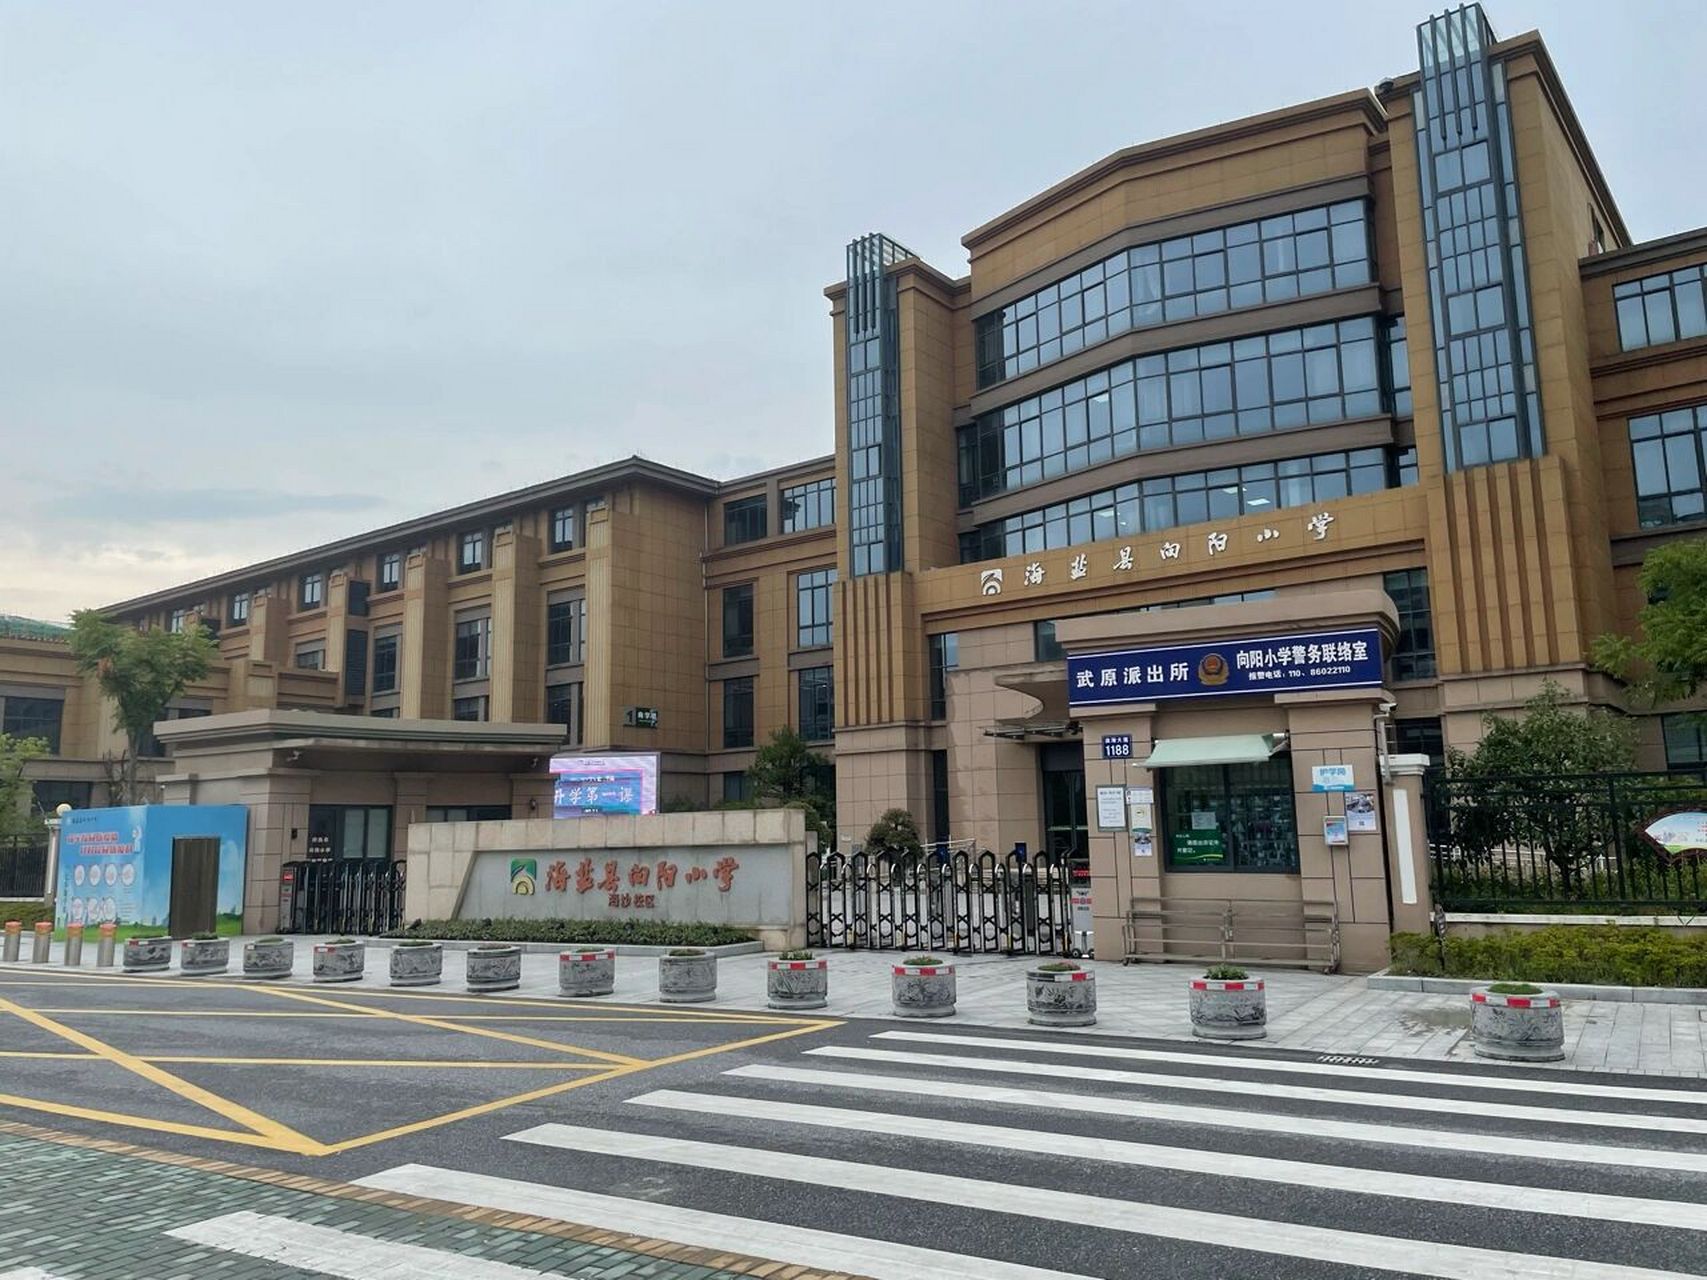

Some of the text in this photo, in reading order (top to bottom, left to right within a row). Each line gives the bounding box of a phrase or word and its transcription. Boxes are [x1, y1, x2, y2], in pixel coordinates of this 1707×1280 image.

[1023, 512, 1335, 586] 海盐县向阳小学
[1236, 641, 1369, 669] 向阳小学警务联络室
[1076, 662, 1189, 688] 武原派出所
[1105, 744, 1129, 756] 1188
[545, 856, 740, 893] 海盐县向阳小学
